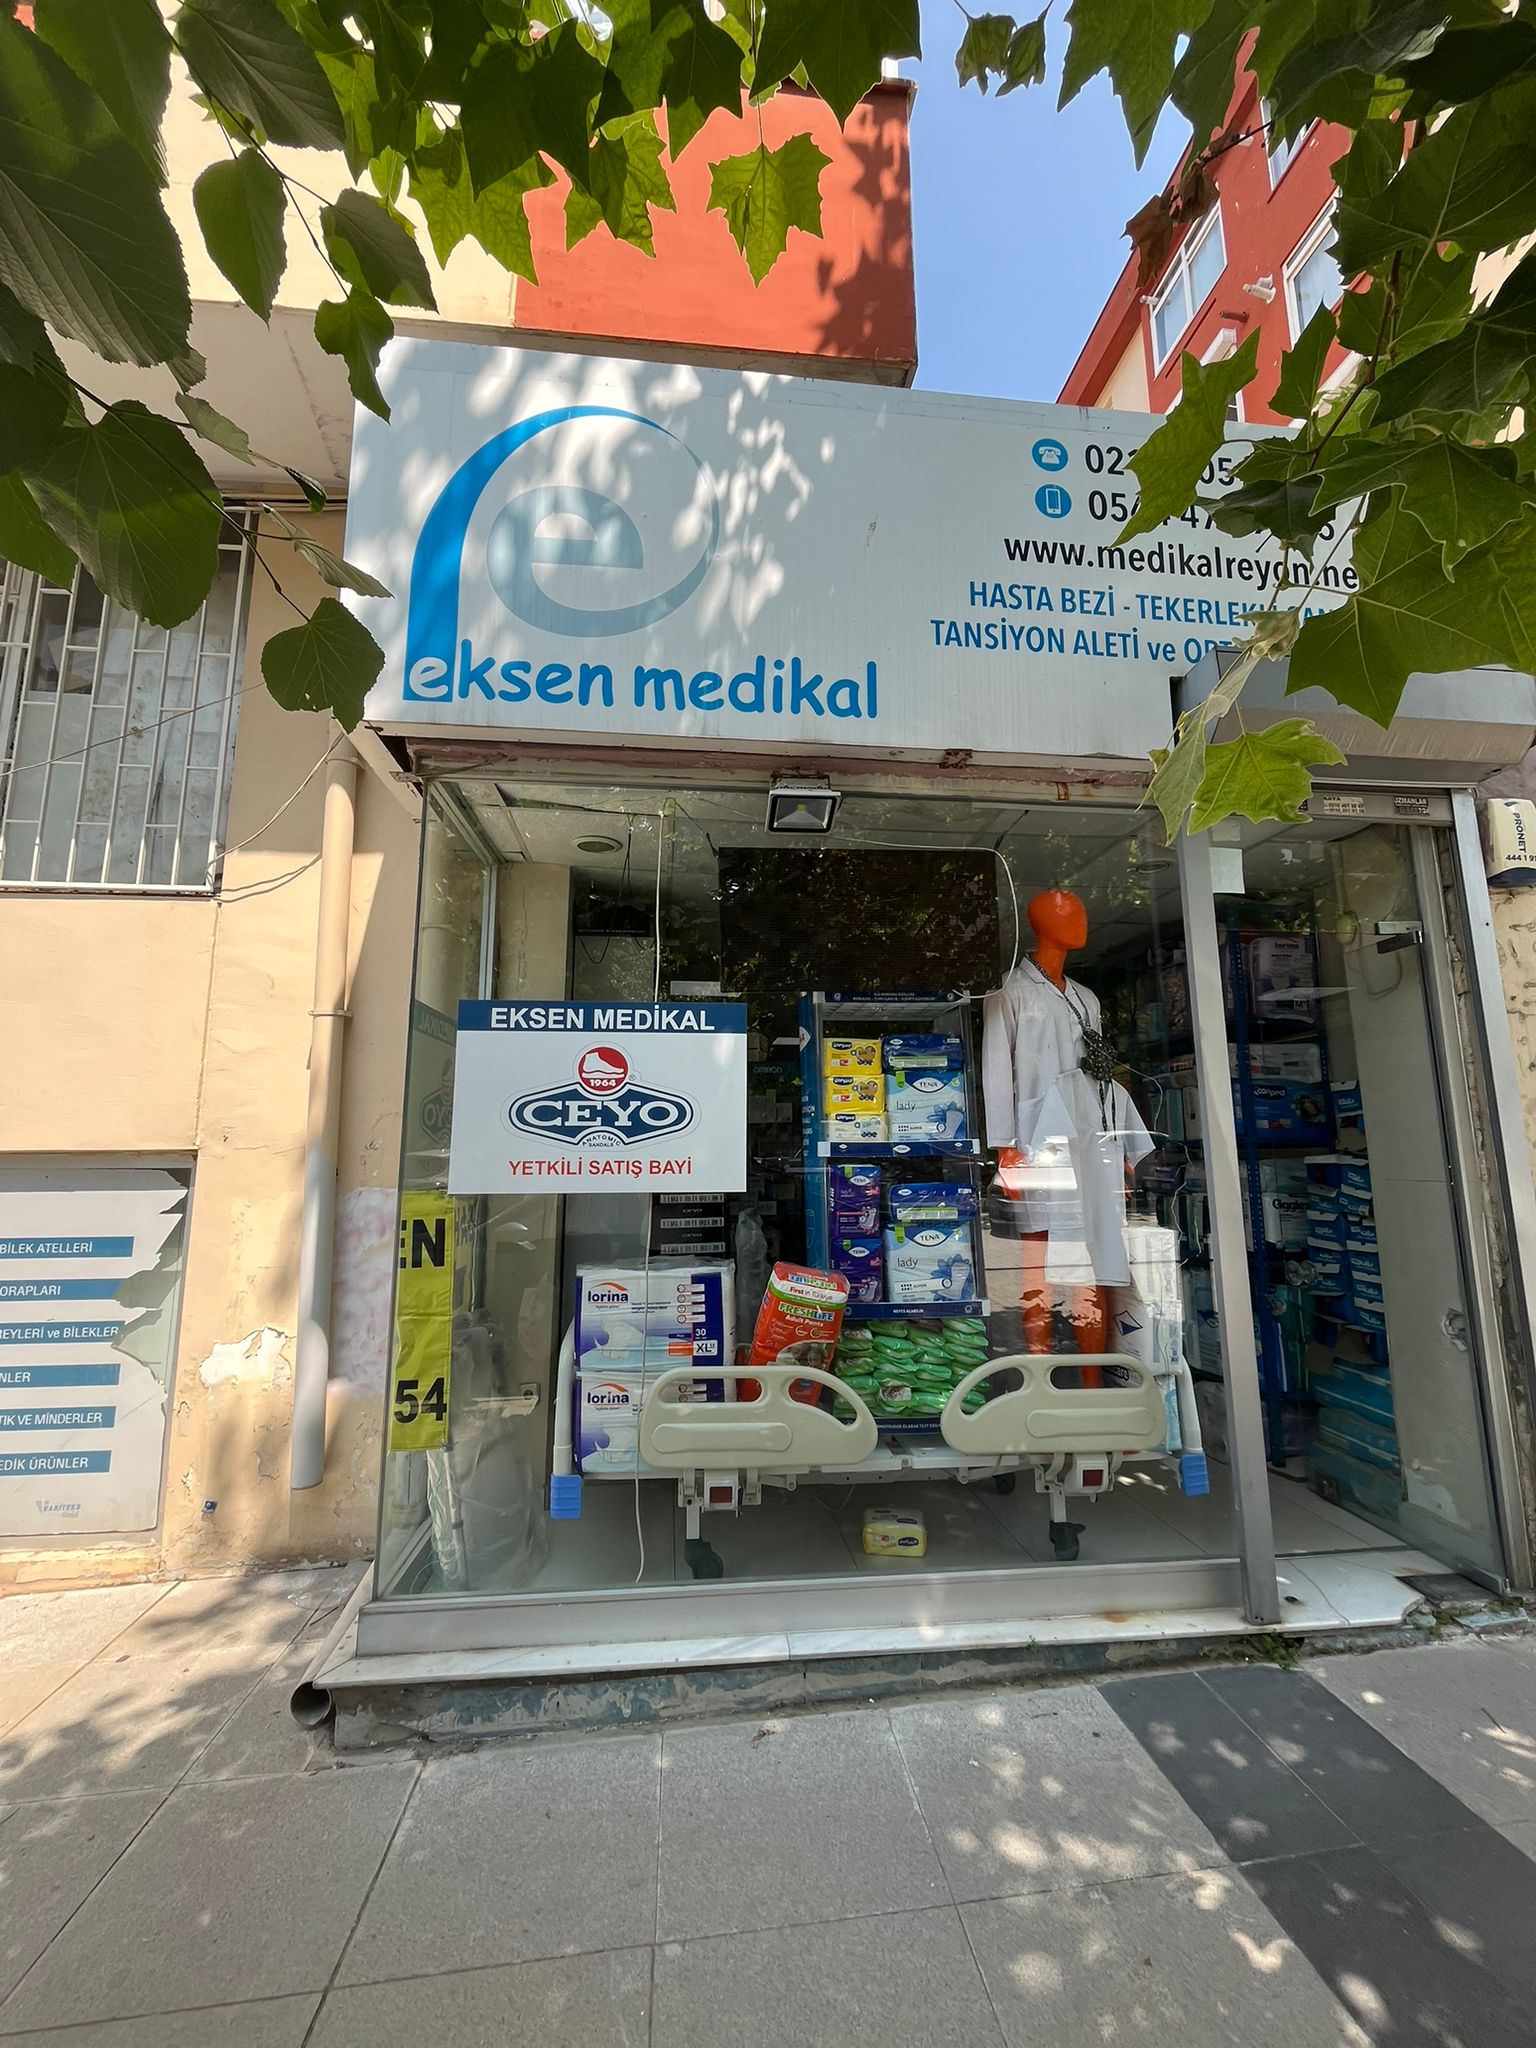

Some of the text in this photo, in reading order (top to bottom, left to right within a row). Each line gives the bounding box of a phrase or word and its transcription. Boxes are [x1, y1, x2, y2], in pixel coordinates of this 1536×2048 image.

[1004, 536, 1358, 591] www.medikalreyon.ne
[969, 581, 1054, 613] HASTA
[1061, 585, 1115, 617] BEZİ
[930, 617, 1066, 656] TANSİYON
[1073, 627, 1140, 660] ALETİ
[1147, 641, 1176, 663] ve
[408, 640, 878, 719] eksen medikal
[1513, 812, 1527, 853] PRONET
[490, 1005, 716, 1031] EKSEN MEDİKAL
[589, 1078, 617, 1087] 1964
[896, 1100, 916, 1112] lady
[523, 1100, 680, 1127] CEYO
[509, 1157, 692, 1178] YETKİLİ SATIŞ BAYİ
[920, 1233, 940, 1242] TENA
[0, 1241, 93, 1254] BİLEK ATELLERİ
[897, 1257, 918, 1270] lady
[587, 1290, 629, 1303] lorina
[789, 1286, 804, 1295] First
[785, 1314, 824, 1327] Adult Pants
[47, 1329, 60, 1339] ve
[63, 1326, 119, 1338] BİLEKLER
[695, 1328, 707, 1337] 30
[695, 1343, 712, 1353] XL
[393, 1377, 447, 1424] 54
[587, 1391, 630, 1405] lorina
[18, 1414, 33, 1425] VE
[35, 1412, 102, 1425] MİNDERLER
[29, 1457, 89, 1471] ÜRÜNLER
